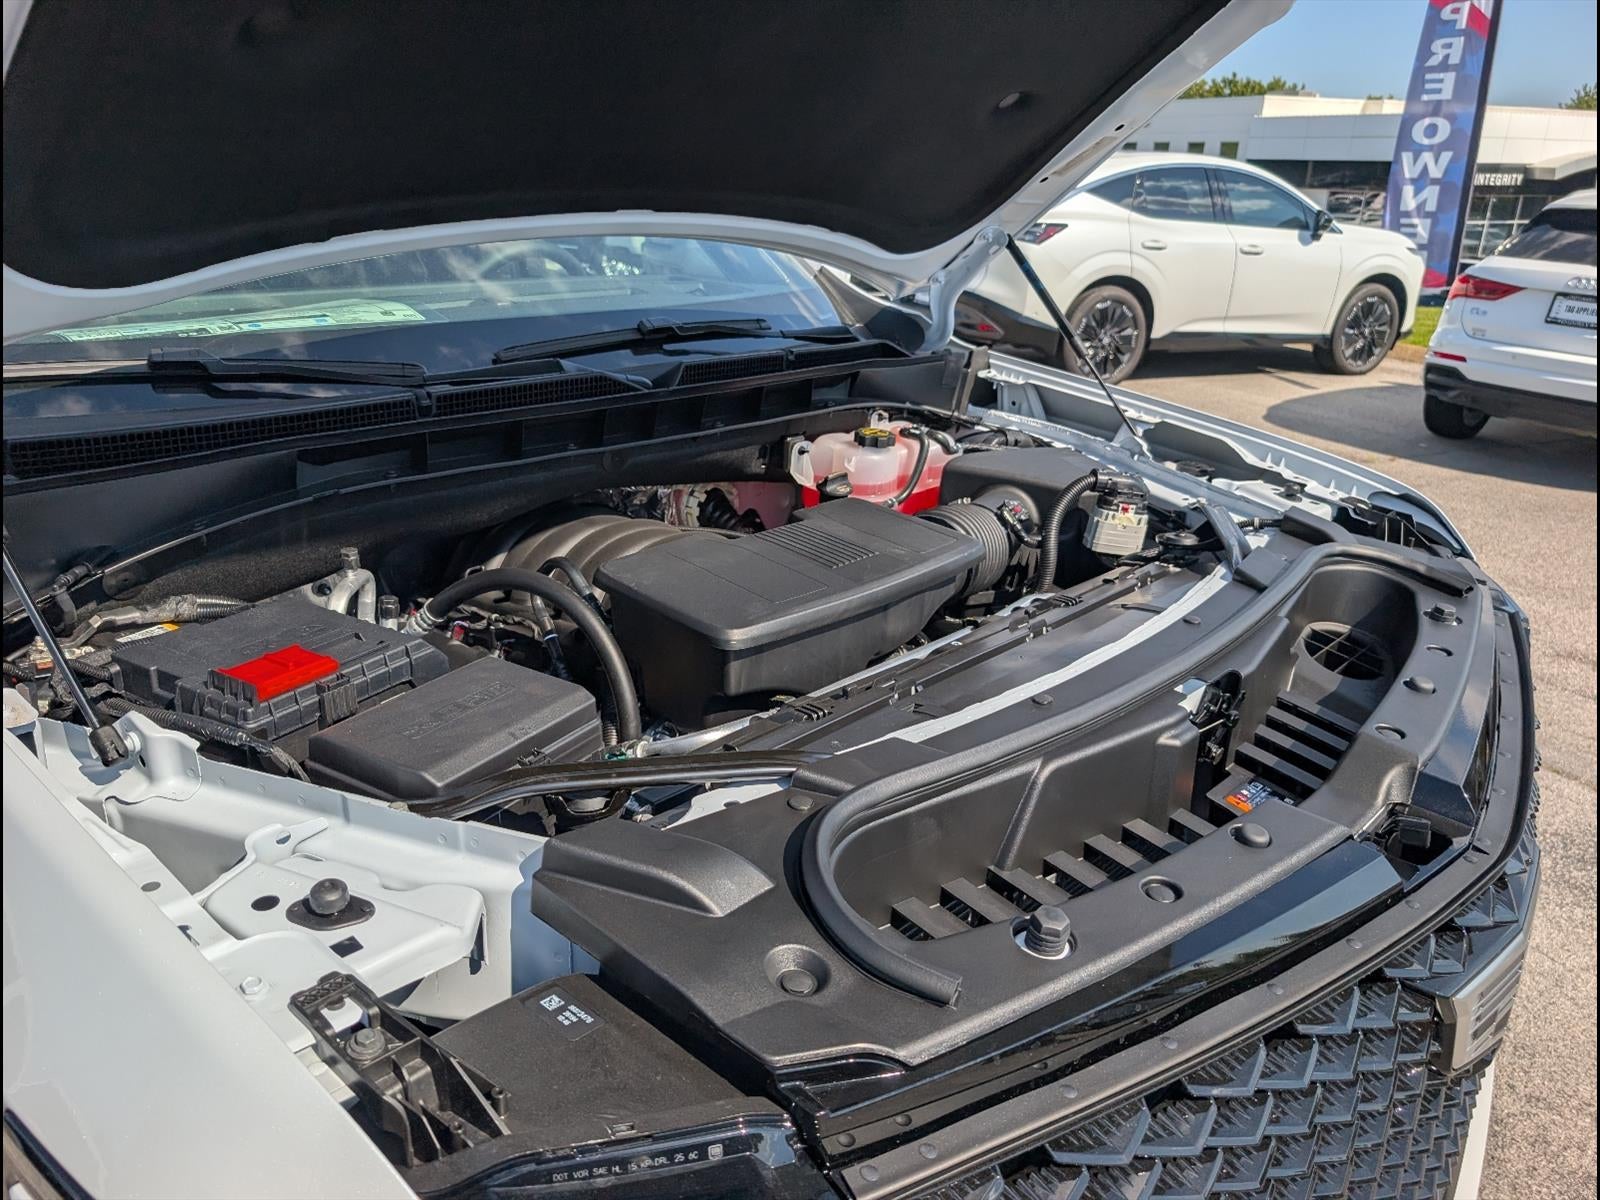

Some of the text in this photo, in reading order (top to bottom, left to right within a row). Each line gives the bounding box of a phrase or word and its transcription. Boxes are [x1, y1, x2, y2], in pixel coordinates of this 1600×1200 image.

[1474, 173, 1524, 186] INTEGRITY
[552, 1172, 569, 1182] DOT
[592, 1166, 609, 1176] SAE
